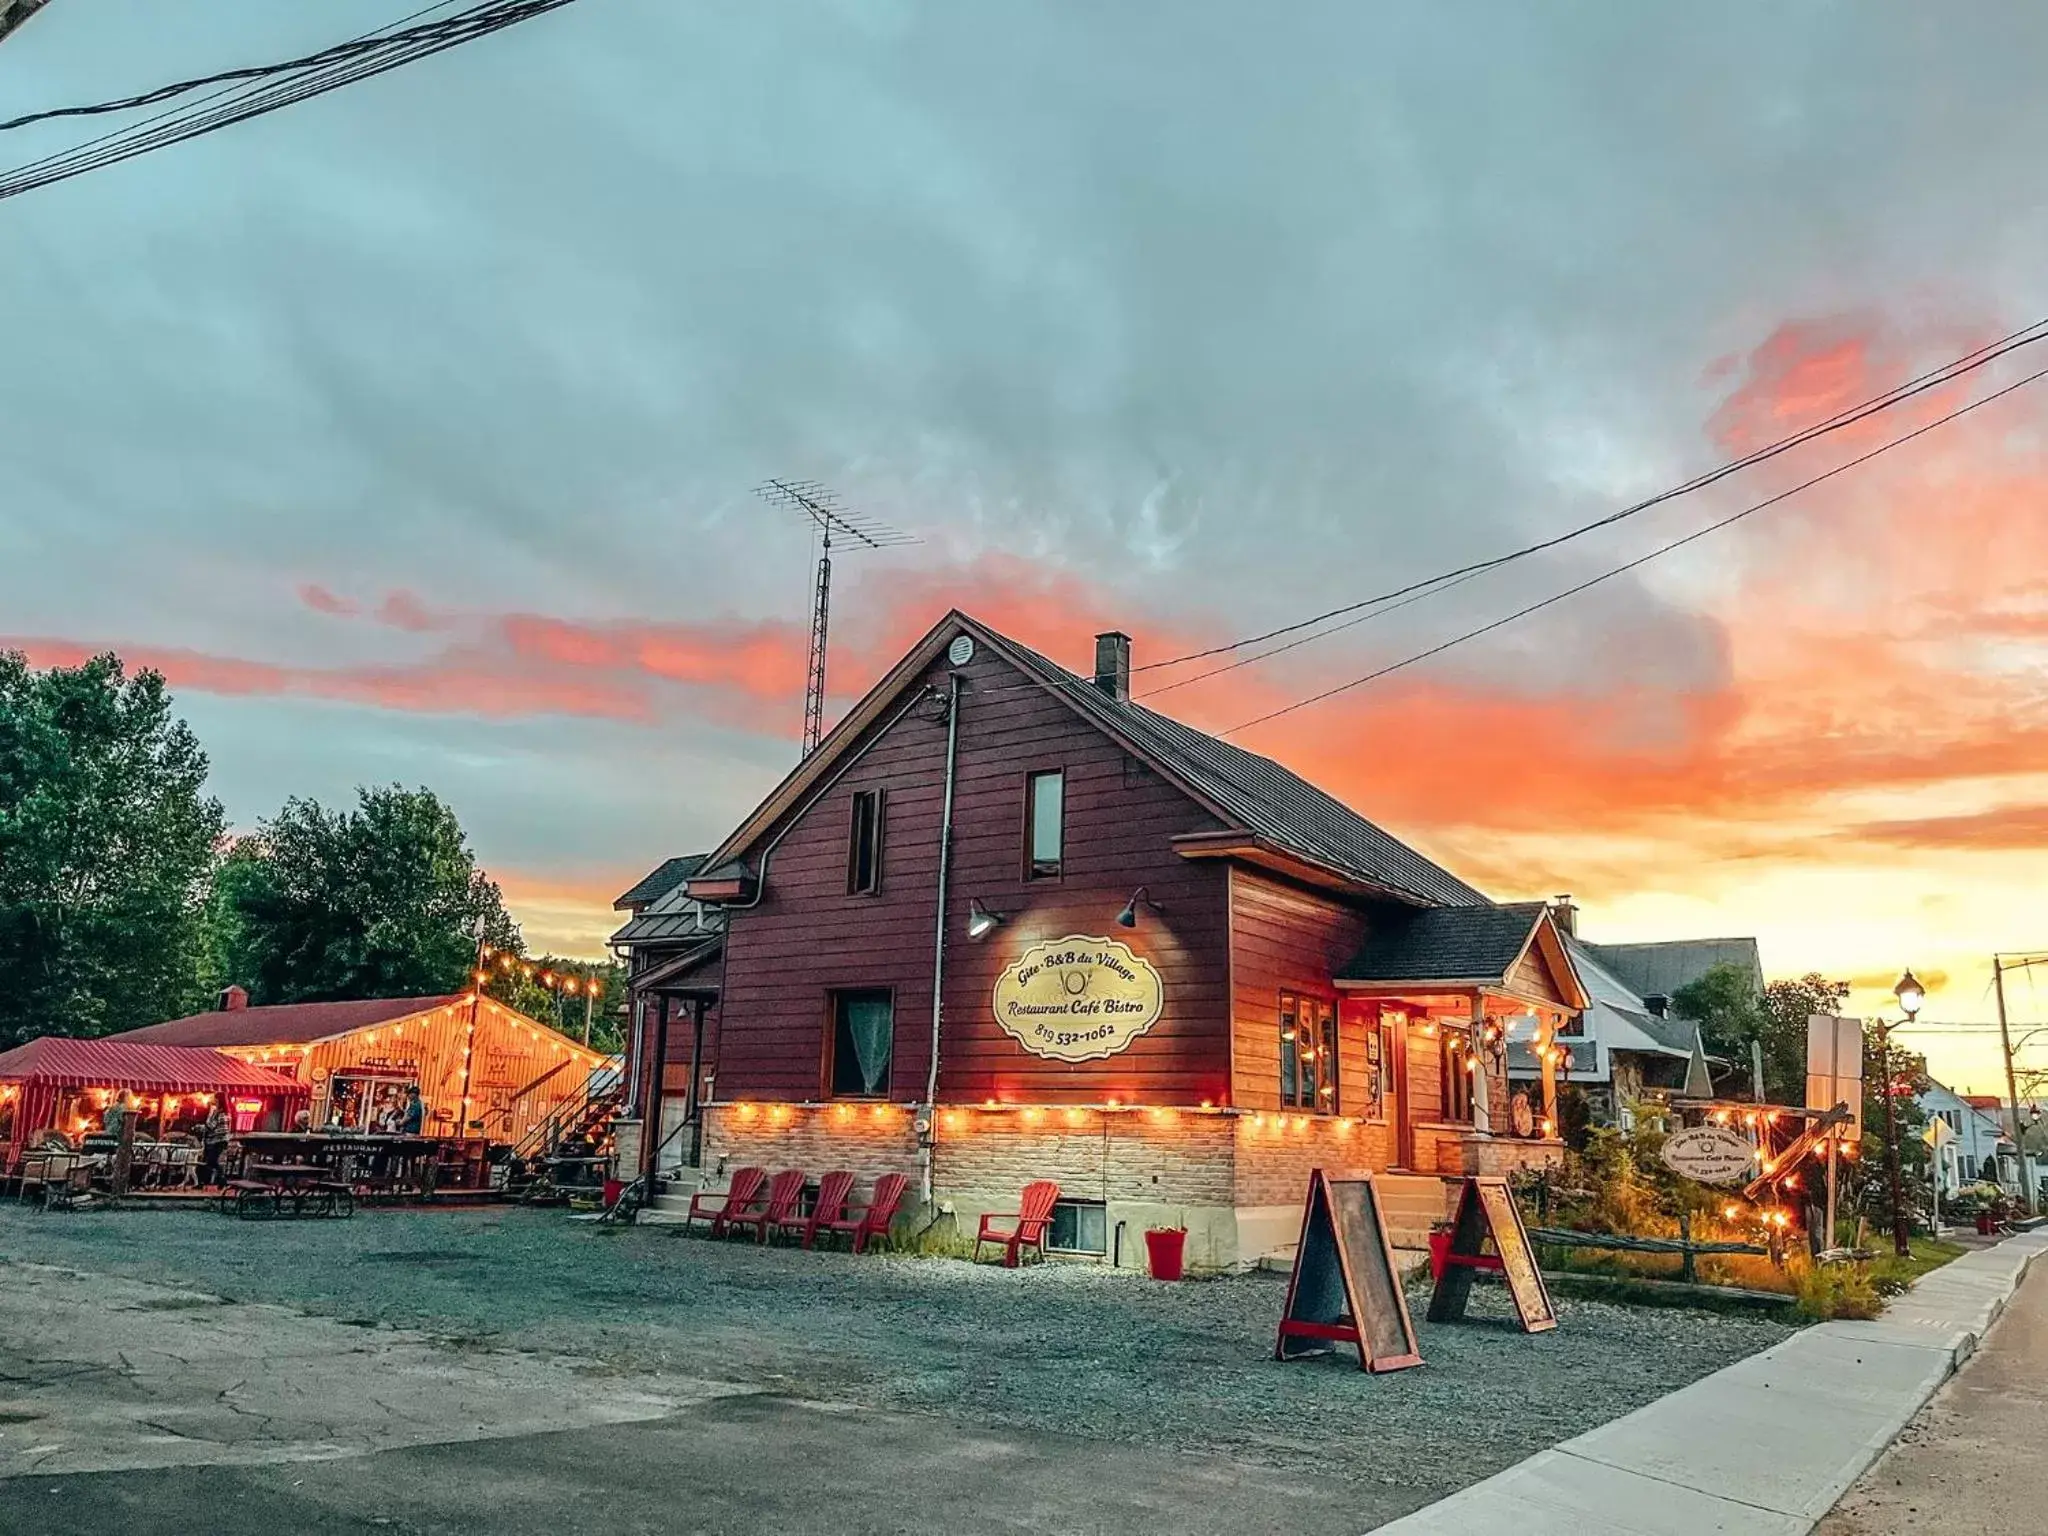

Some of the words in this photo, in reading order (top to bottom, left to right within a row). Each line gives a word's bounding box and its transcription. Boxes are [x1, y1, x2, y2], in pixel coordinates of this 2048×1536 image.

[1043, 951, 1076, 968] B&B
[1077, 952, 1093, 964] du
[1095, 952, 1136, 982] Village
[1007, 1001, 1069, 1017] Restaurant
[1070, 999, 1101, 1016] Café
[1103, 998, 1144, 1014] Bistro
[1034, 1023, 1055, 1043] 819
[1055, 1024, 1115, 1046] 532-1062
[322, 1145, 384, 1153] RESTAURANT
